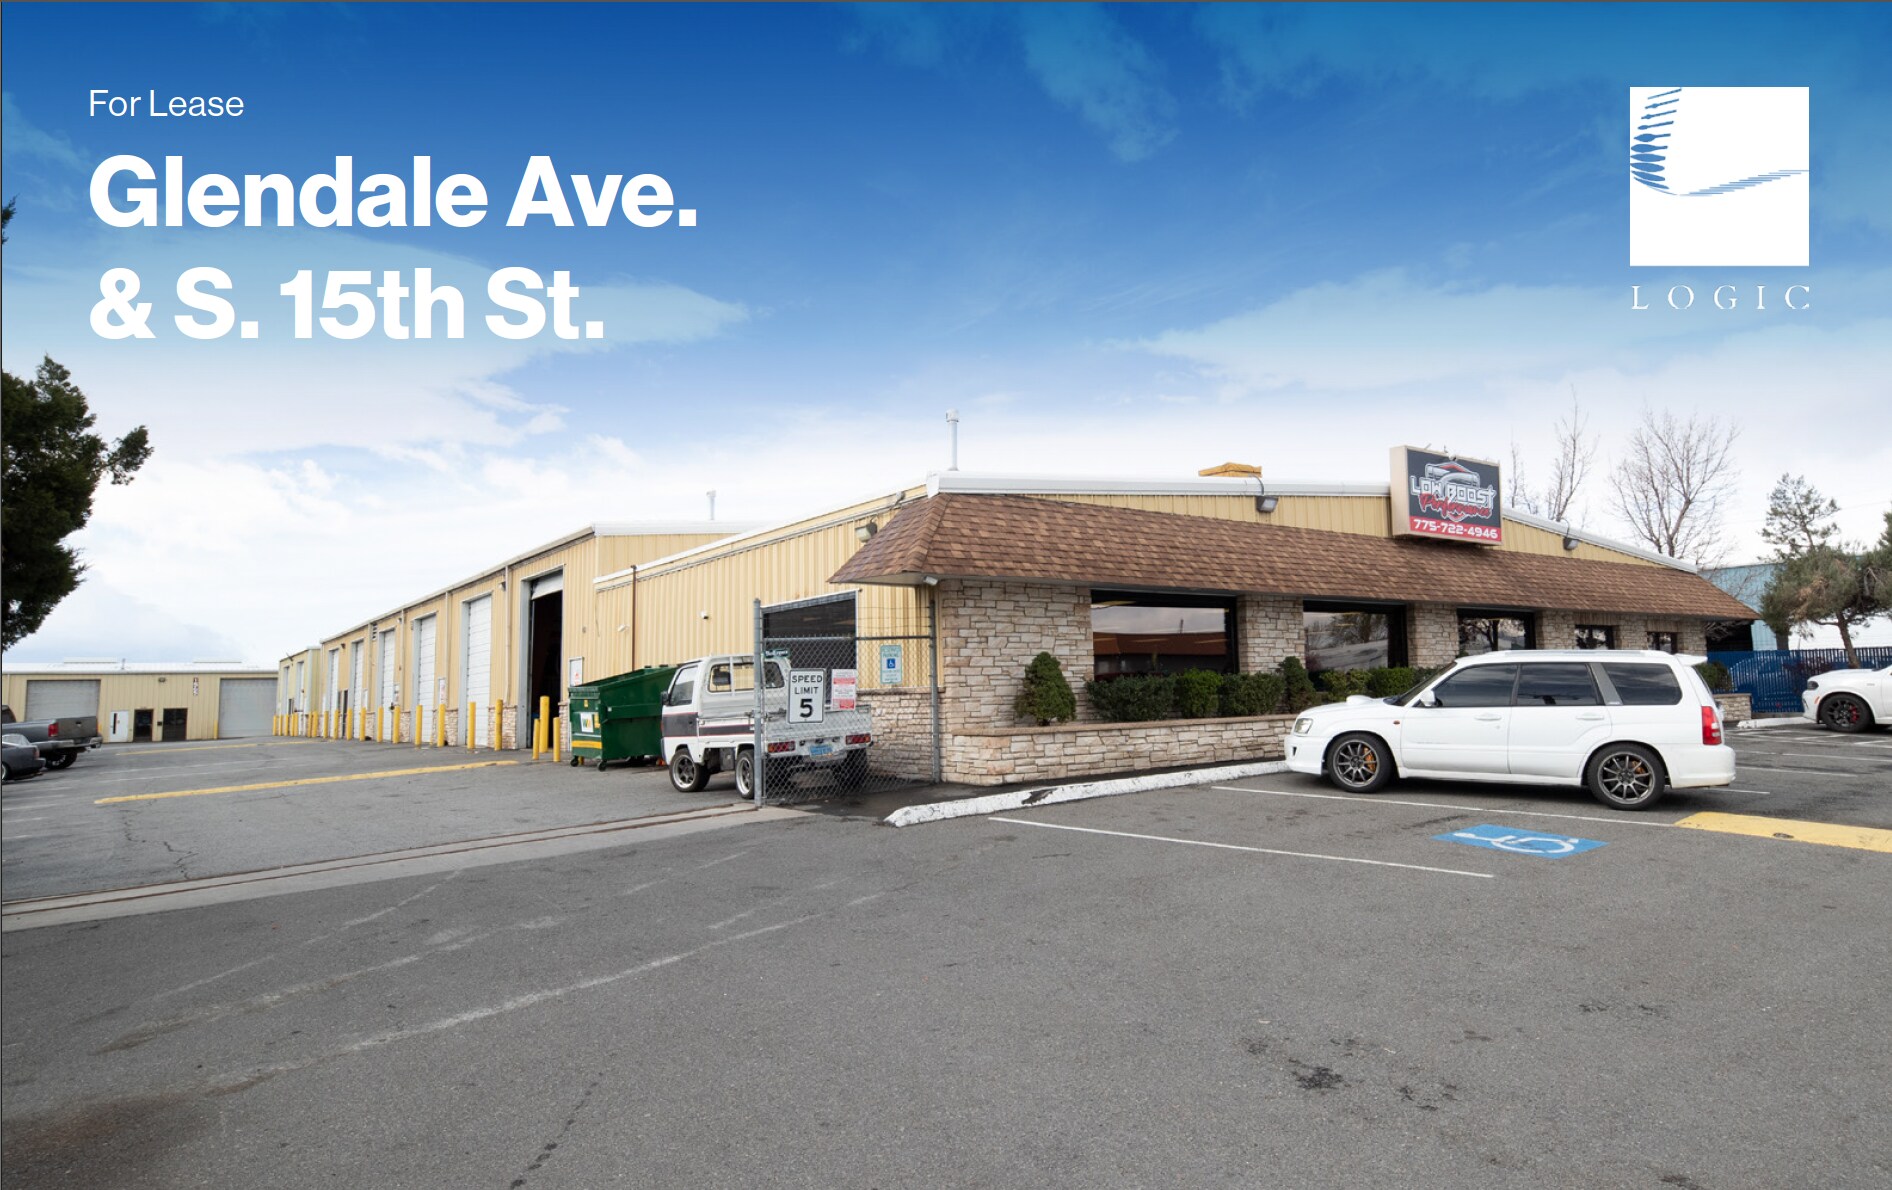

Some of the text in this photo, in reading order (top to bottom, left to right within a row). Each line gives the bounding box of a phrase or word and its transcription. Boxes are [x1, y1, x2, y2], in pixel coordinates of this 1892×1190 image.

[1410, 475, 1440, 501] LOW
[1413, 518, 1499, 539] 775-722-4946
[791, 674, 823, 683] SPEED
[794, 686, 819, 695] LIMIT
[799, 698, 813, 718] 5
